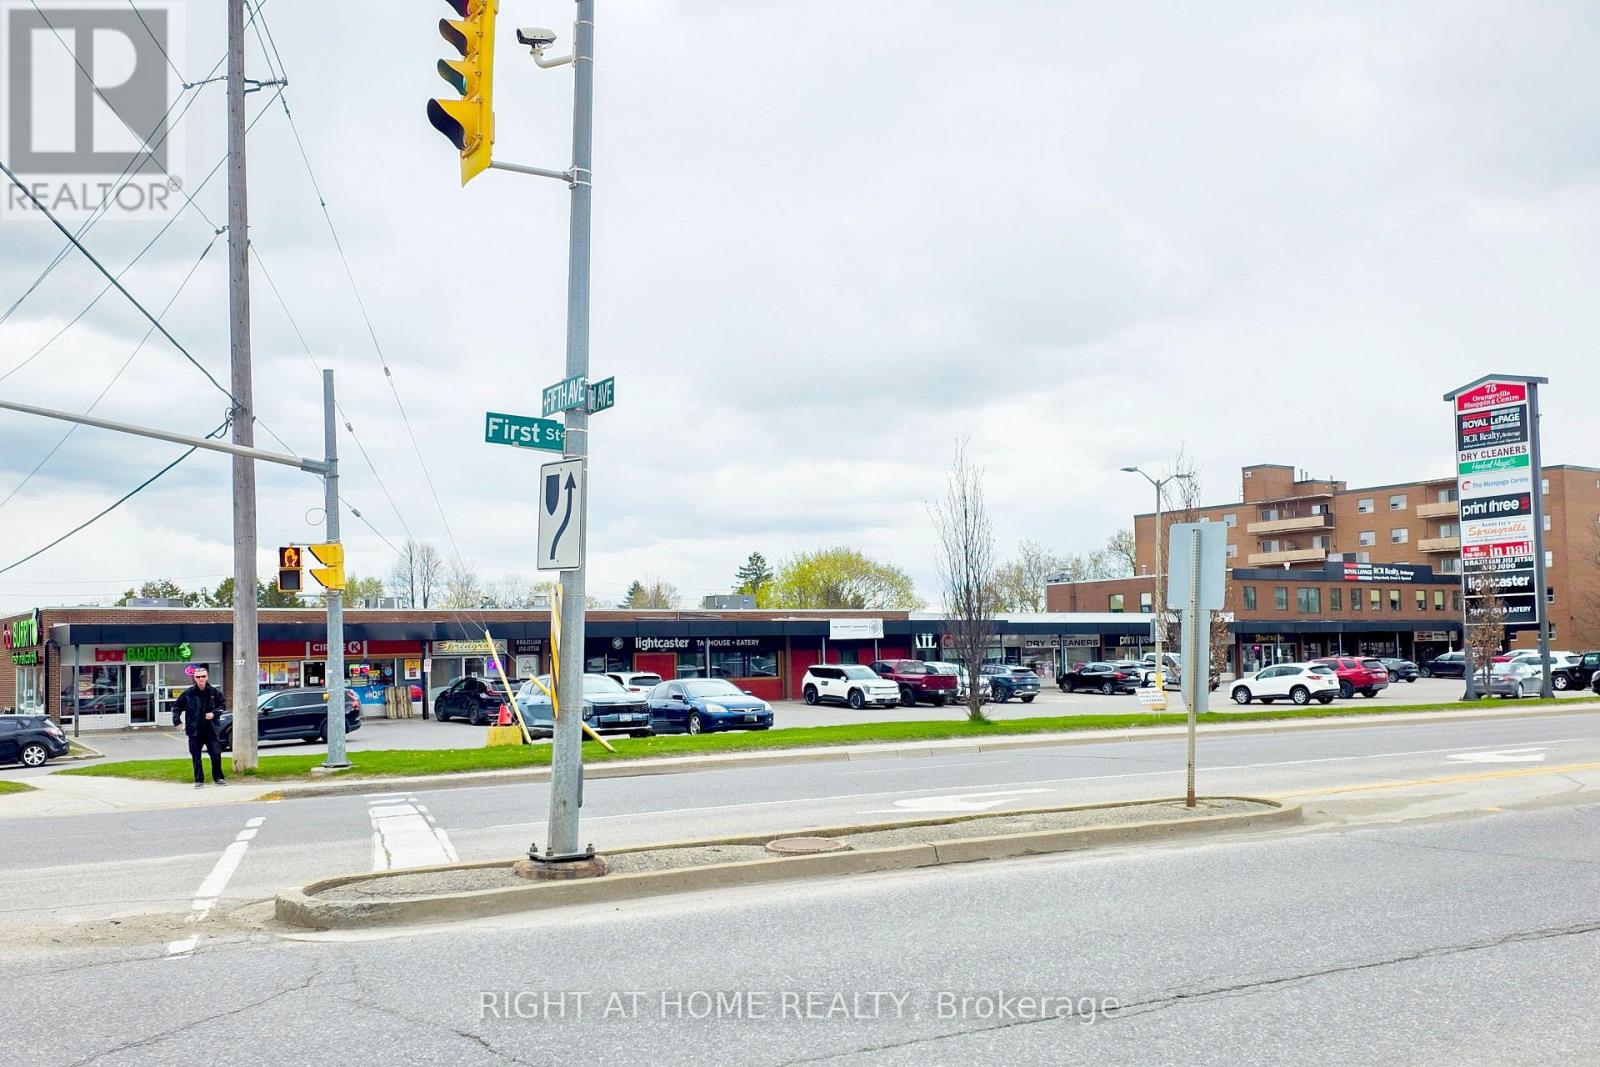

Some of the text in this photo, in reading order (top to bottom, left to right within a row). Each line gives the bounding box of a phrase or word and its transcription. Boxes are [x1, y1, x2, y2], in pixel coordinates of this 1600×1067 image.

[546, 383, 568, 413] FIFTH
[567, 376, 585, 405] AVE
[1485, 384, 1497, 393] 75
[596, 381, 613, 410] AVE
[1463, 394, 1520, 409] Shopping Centre
[1472, 390, 1511, 402] Orangeville
[1462, 417, 1488, 429] ROYAL
[487, 417, 561, 443] First St
[1463, 434, 1478, 443] RCR
[1461, 445, 1527, 461] DRY CLEANERS
[1483, 479, 1510, 487] Mortgage
[1462, 501, 1487, 517] print
[1489, 499, 1519, 512] three
[1468, 523, 1526, 538] Springrolls
[1489, 544, 1503, 557] in
[1505, 541, 1533, 556] nail
[1514, 554, 1533, 562] JITSU
[1508, 605, 1532, 613] EATERY
[348, 640, 361, 653] K
[635, 637, 690, 651] lightcaster
[1050, 639, 1099, 647] CLEANERS
[1119, 634, 1135, 646] print
